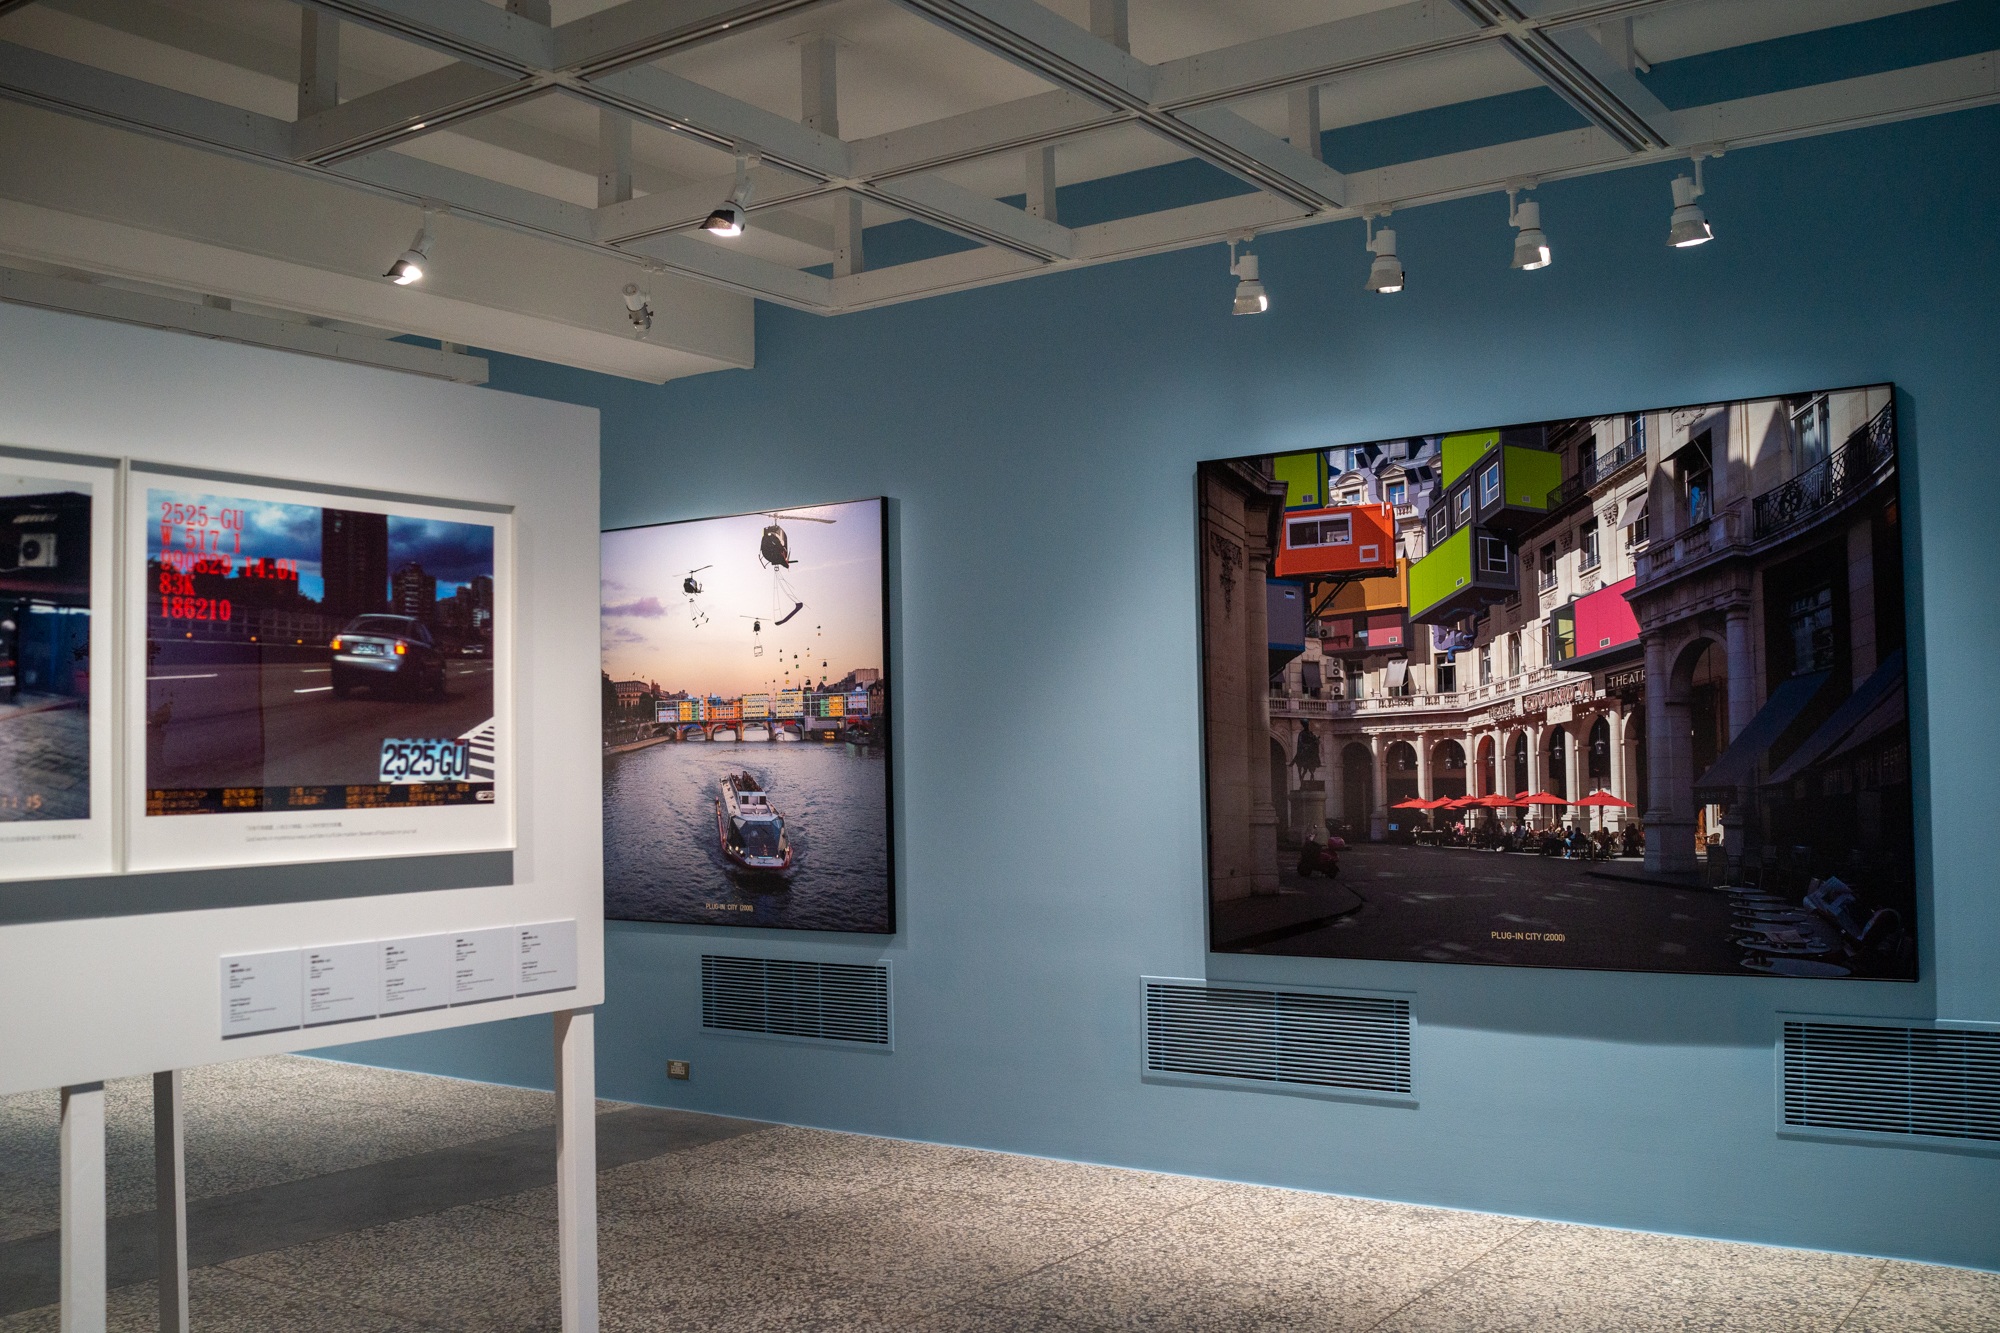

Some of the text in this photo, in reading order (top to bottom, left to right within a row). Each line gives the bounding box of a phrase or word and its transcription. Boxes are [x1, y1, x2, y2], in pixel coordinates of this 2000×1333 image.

[161, 502, 244, 531] 2525-GU
[161, 525, 241, 553] W 517 1
[160, 549, 298, 581] 990829 14:01
[160, 596, 231, 620] 186210
[382, 743, 466, 776] 2525-GU
[727, 903, 738, 911] CITY
[1491, 931, 1566, 943] PLUG-IN CITY (2000)
